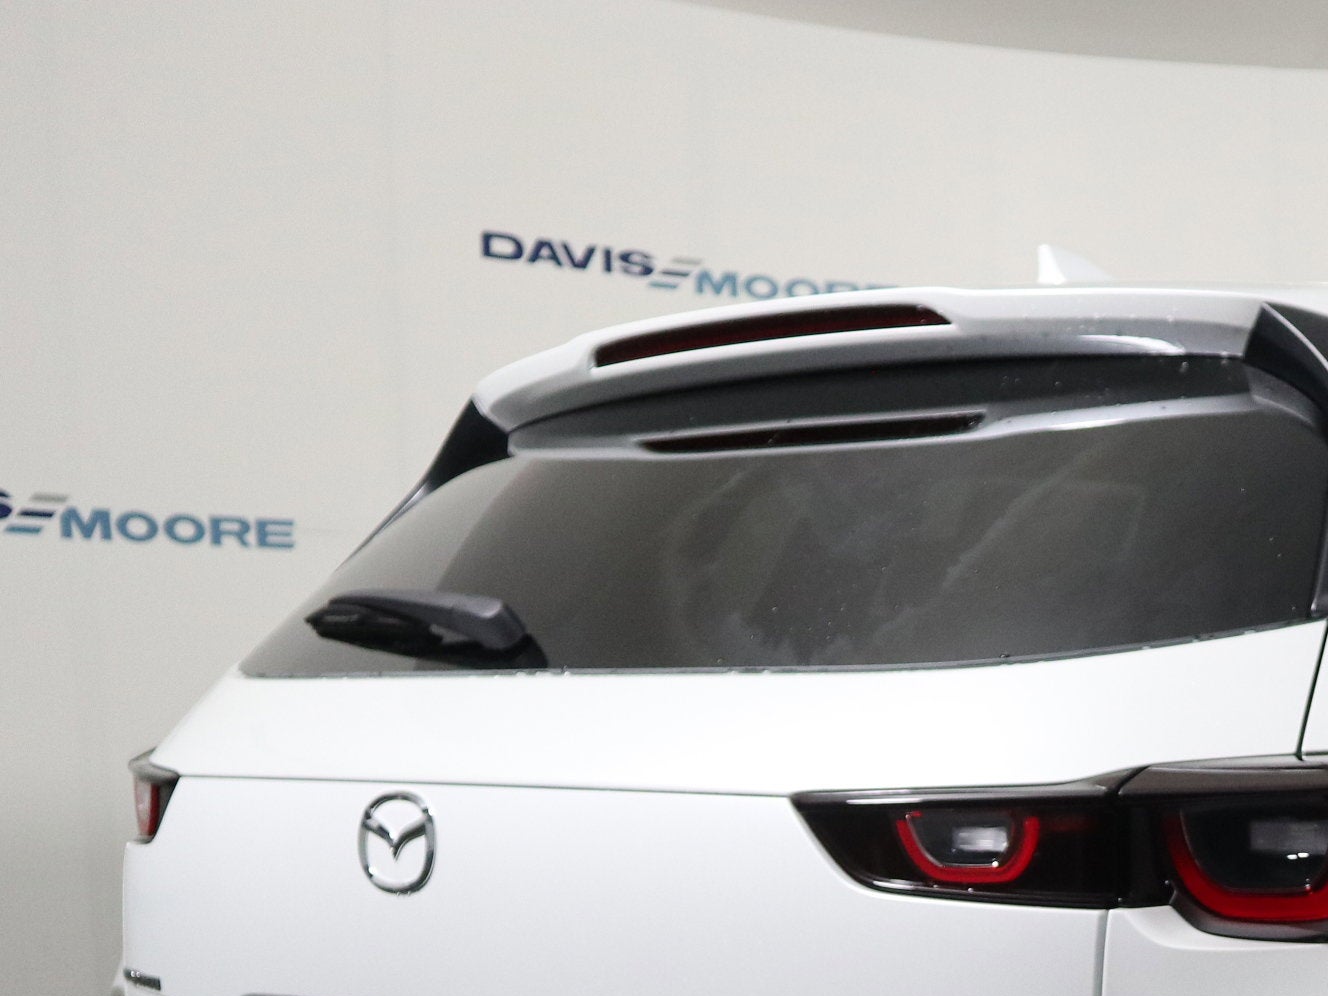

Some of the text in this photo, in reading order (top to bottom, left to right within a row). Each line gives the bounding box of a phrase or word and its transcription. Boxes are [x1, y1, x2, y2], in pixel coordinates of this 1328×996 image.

[481, 231, 900, 300] DAVIS MOO
[60, 506, 295, 549] MOORE
